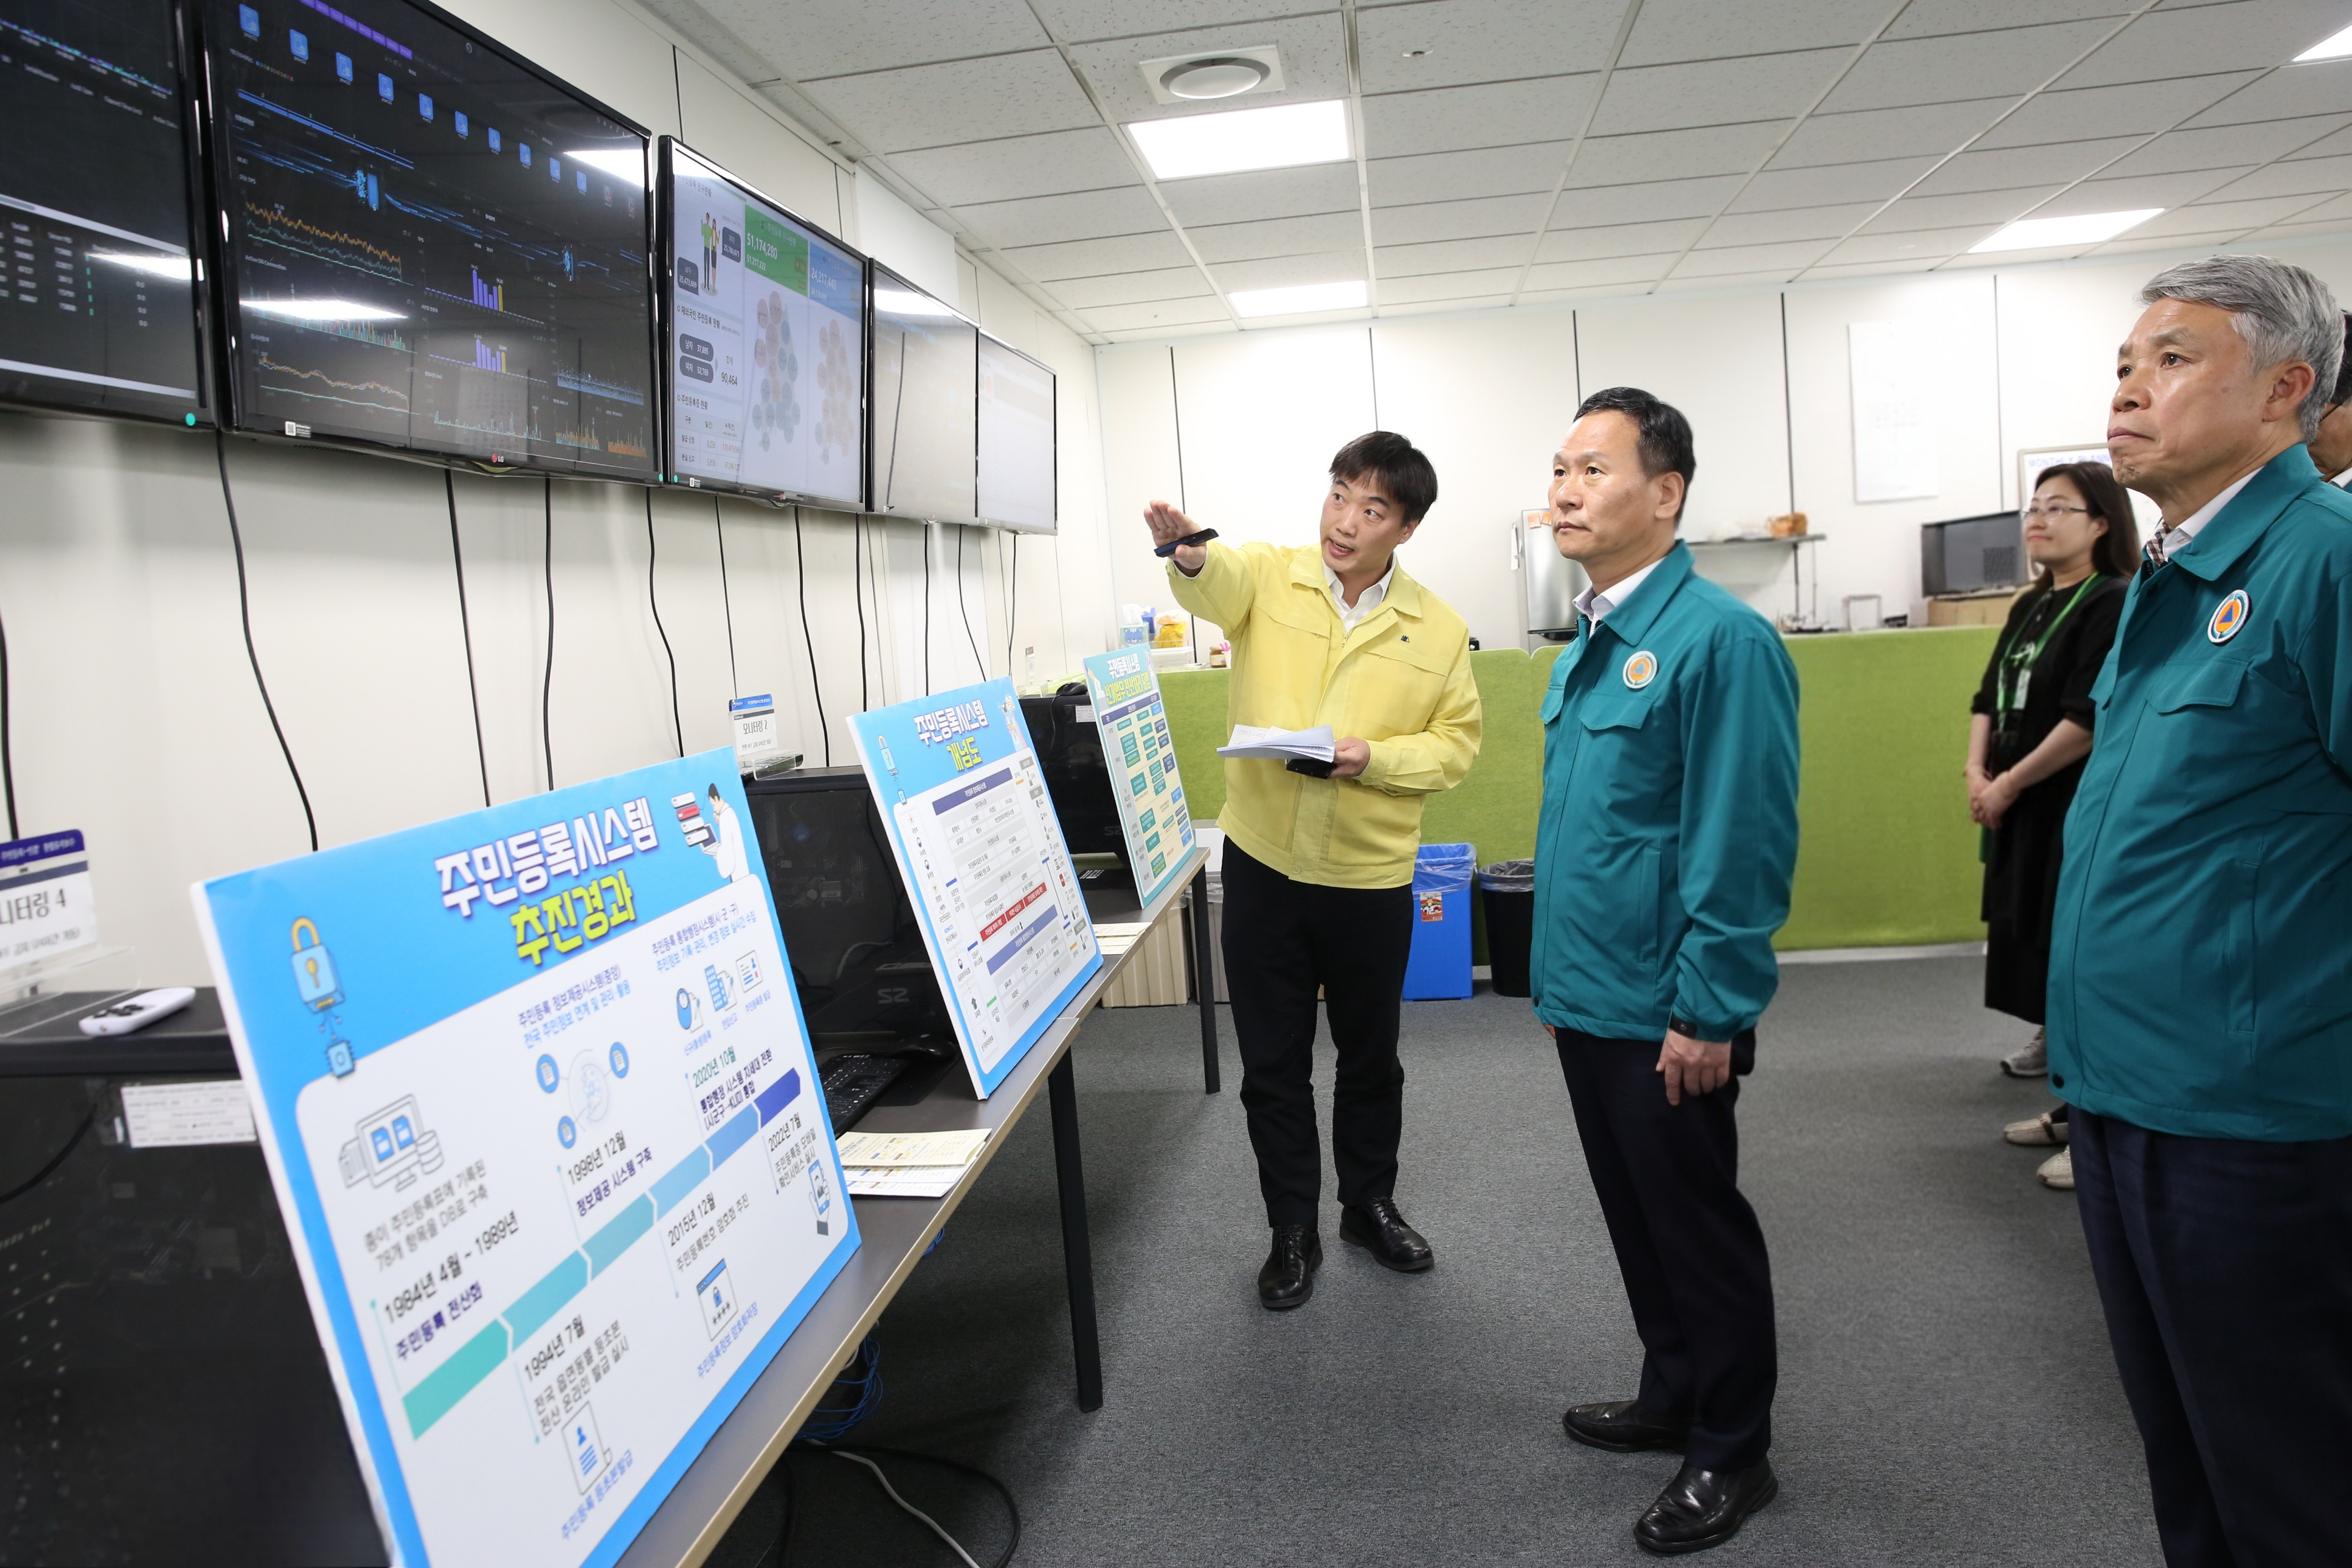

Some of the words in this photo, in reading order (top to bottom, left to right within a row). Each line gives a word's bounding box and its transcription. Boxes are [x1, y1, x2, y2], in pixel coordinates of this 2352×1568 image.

[747, 233, 777, 259] 51,174,280
[811, 267, 837, 291] 24,217,440
[681, 306, 696, 320] 재외국민
[697, 312, 712, 326] 주민등록
[713, 318, 720, 329] 현황
[685, 339, 693, 350] 남자
[685, 362, 693, 373] 여자
[721, 372, 737, 386] 90,464
[681, 395, 700, 408] 주민등록증
[701, 400, 708, 410] 현황
[1107, 653, 1141, 679] 주민등록시스템
[743, 720, 763, 735] 모니터링
[764, 720, 767, 729] 2
[914, 699, 989, 745] 주민등록시스템
[947, 736, 982, 771] 개념도
[435, 796, 658, 917] 주민등록시스템
[55, 888, 66, 908] 4
[510, 869, 636, 965] 추진경과
[651, 935, 676, 957] 주민등록
[656, 951, 681, 974] 주민정보
[707, 930, 720, 946] 변경
[719, 924, 731, 939] 정보
[730, 916, 746, 933] 실시간
[745, 910, 756, 925] 수집
[518, 1000, 551, 1029] 주민등록
[542, 1010, 574, 1038] 주민정보
[692, 1058, 719, 1088] 2020년
[719, 1046, 736, 1069] 10월
[700, 1085, 725, 1113] 통합행정
[725, 1071, 744, 1094] 시스템
[743, 1057, 761, 1079] 차세대
[760, 1048, 773, 1066] 전환
[743, 1080, 756, 1098] 통합
[768, 1123, 791, 1152] 2022년
[789, 1112, 802, 1132] 7월
[568, 1148, 603, 1186] 1998년
[603, 1130, 627, 1159] 12월
[775, 1143, 801, 1175] 주민등록증
[800, 1127, 816, 1149] 모바일
[778, 1157, 805, 1189] 확인서비스
[804, 1146, 816, 1164] 실시
[456, 1159, 487, 1192] 기록된
[577, 1180, 611, 1216] 정보제공
[610, 1159, 636, 1189] 시스템
[635, 1147, 653, 1169] 구축
[668, 1210, 698, 1246] 2015년
[697, 1192, 716, 1219] 12월
[676, 1225, 717, 1273] 주민등록번호
[716, 1206, 736, 1233] 암호화
[735, 1193, 750, 1214] 추진
[384, 1272, 436, 1325] 1984년
[437, 1253, 462, 1286] 4월
[475, 1211, 519, 1257] 1989년
[396, 1311, 445, 1362] 주민등록
[448, 1281, 483, 1320] 전산화
[525, 1335, 565, 1383] 1994년
[565, 1315, 585, 1346] 7월
[534, 1384, 556, 1416] 전국
[539, 1404, 562, 1437] 전산
[562, 1374, 591, 1413] 온라인
[591, 1355, 610, 1383] 발급
[610, 1335, 630, 1363] 실시
